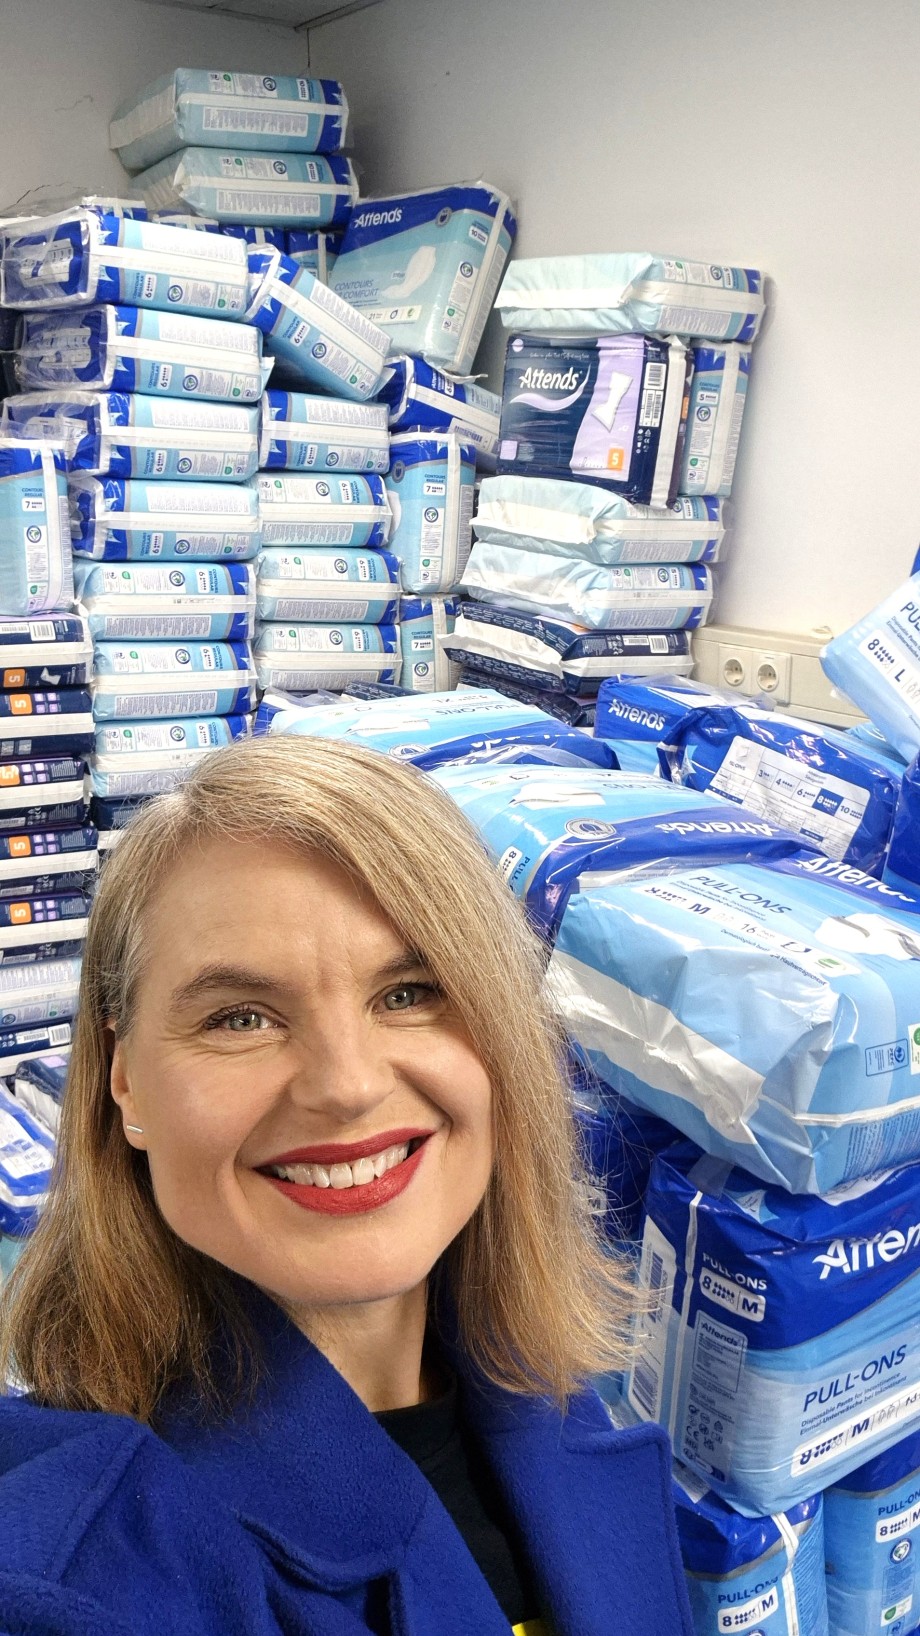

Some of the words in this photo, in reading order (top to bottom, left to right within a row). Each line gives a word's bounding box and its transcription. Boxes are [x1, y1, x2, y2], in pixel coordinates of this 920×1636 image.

[353, 207, 403, 229] Attends
[294, 335, 301, 344] 6
[518, 366, 579, 390] Attends
[611, 452, 619, 466] 5
[426, 485, 432, 493] 7
[25, 500, 30, 509] 7
[868, 638, 880, 651] 8
[895, 668, 905, 683] L
[14, 700, 27, 708] 5
[608, 698, 666, 731] Attends
[758, 769, 764, 778] 3
[775, 778, 783, 786] 4
[797, 788, 803, 797] 6
[816, 794, 825, 805] 8
[840, 804, 850, 814] 10
[653, 821, 780, 837] Attends
[13, 841, 26, 850] 5
[508, 850, 517, 859] 8
[689, 876, 792, 913] PULL-ONS
[14, 908, 27, 917] 5
[688, 903, 712, 915] M
[741, 923, 758, 934] 16
[702, 1252, 767, 1291] PULL-ONS
[701, 1275, 712, 1290] 8
[742, 1297, 759, 1315] M
[701, 1321, 738, 1347] Attends
[803, 1344, 907, 1412] PULL-ONS
[801, 1405, 836, 1428] Disposable
[836, 1396, 854, 1412] Pants
[800, 1448, 813, 1466] 8
[851, 1417, 870, 1438] M
[880, 1525, 888, 1537] 8
[722, 1615, 733, 1627] 8
[761, 1594, 774, 1612] M
